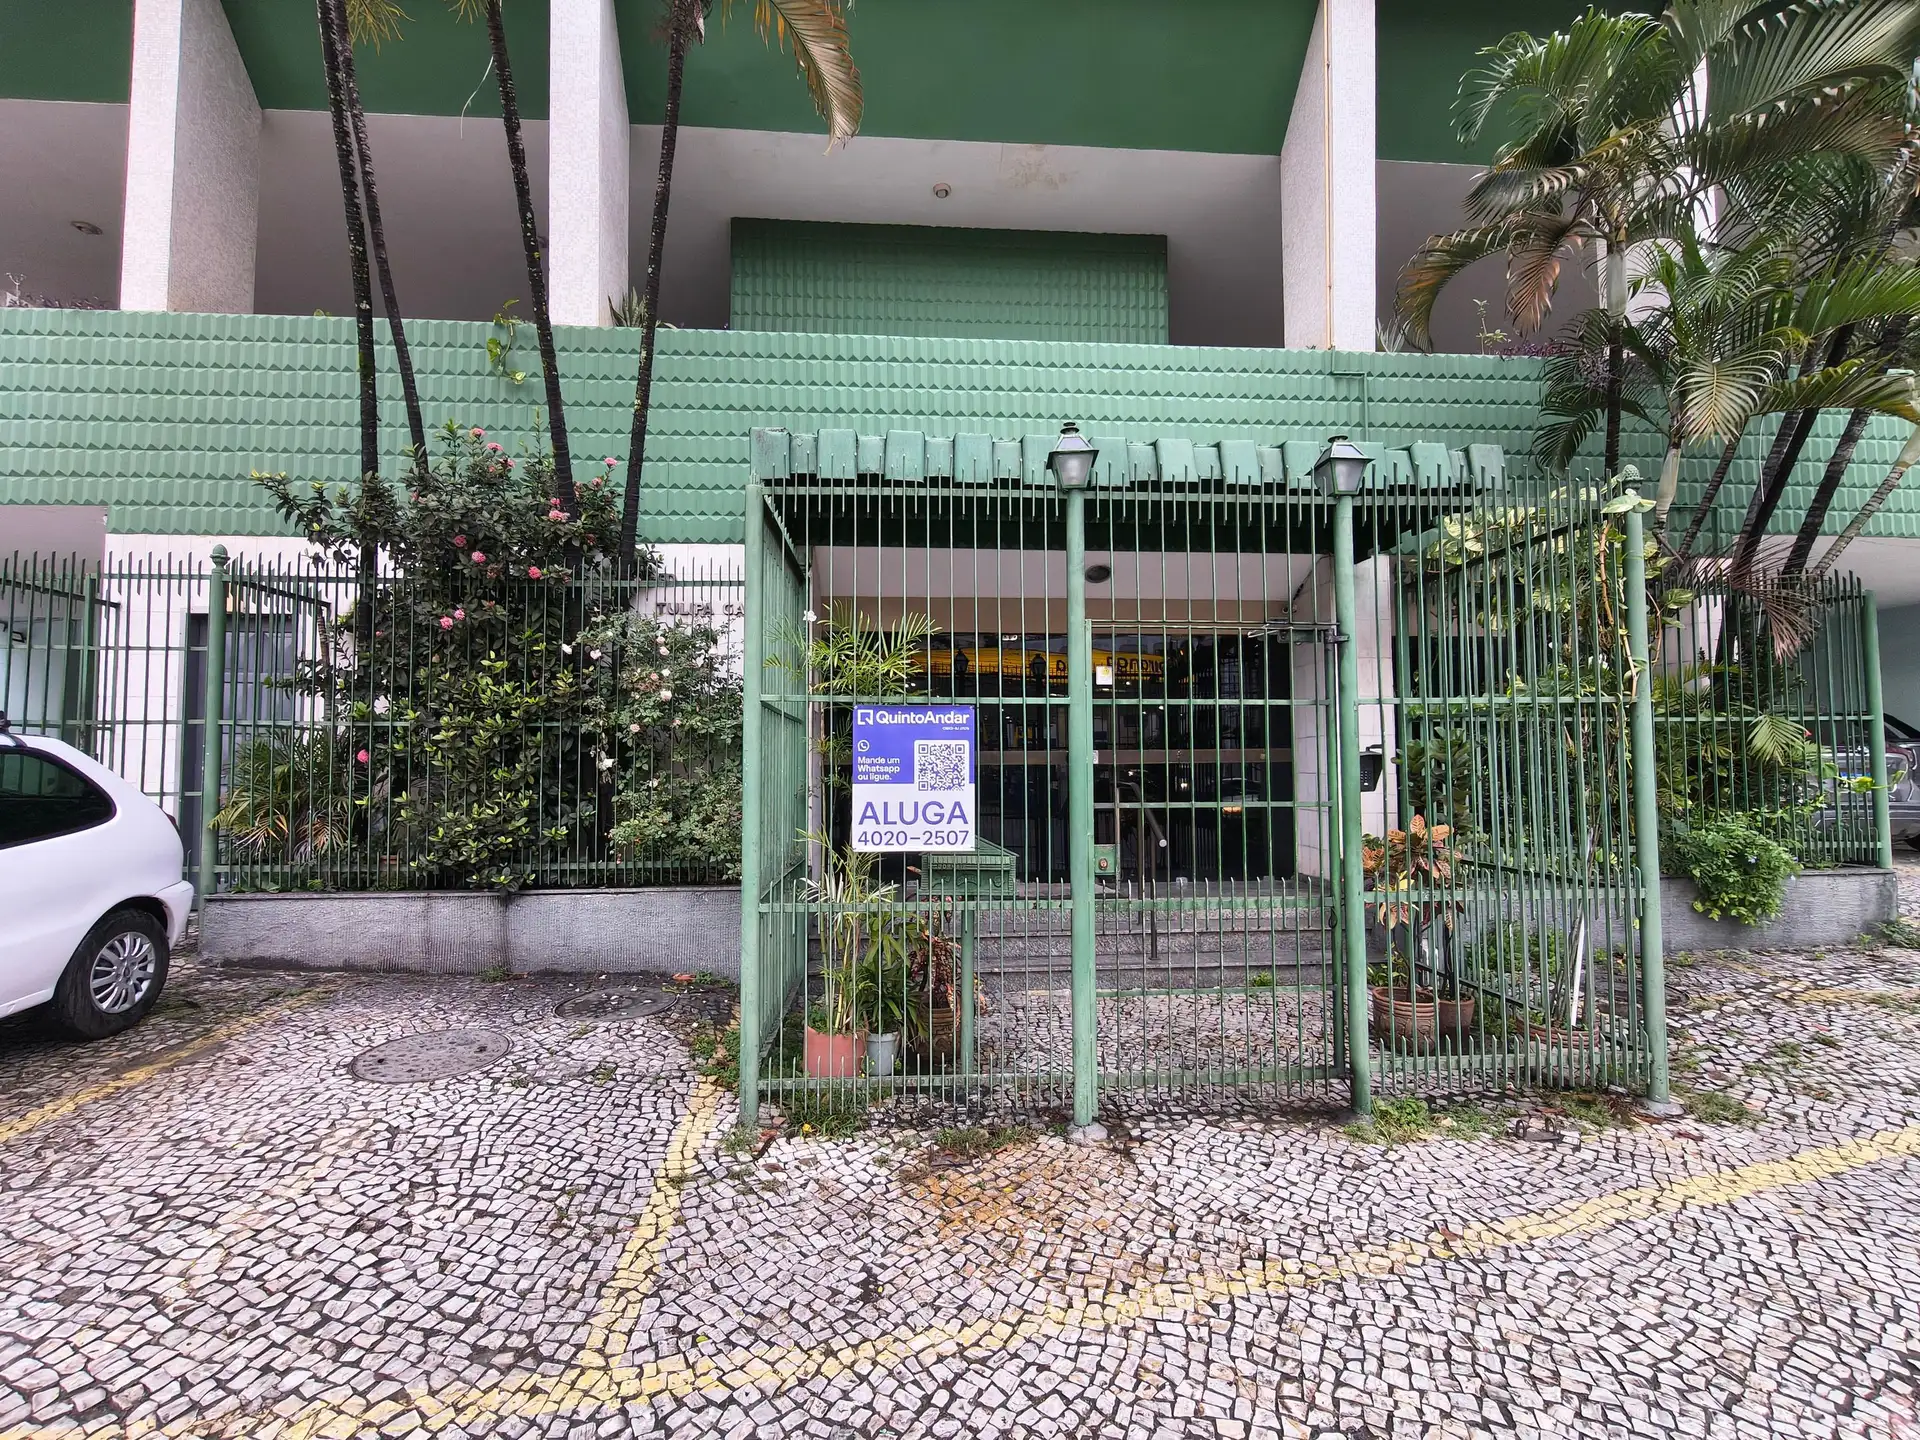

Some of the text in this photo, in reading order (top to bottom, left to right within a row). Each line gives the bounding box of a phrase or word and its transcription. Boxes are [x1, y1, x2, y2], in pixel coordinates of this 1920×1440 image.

[876, 710, 970, 725] QuintoAndar
[857, 756, 886, 764] Mande
[857, 764, 900, 774] Whatsapp
[869, 773, 892, 782] ligue.
[858, 801, 969, 825] ALUGA
[858, 830, 970, 846] 4020-2507
